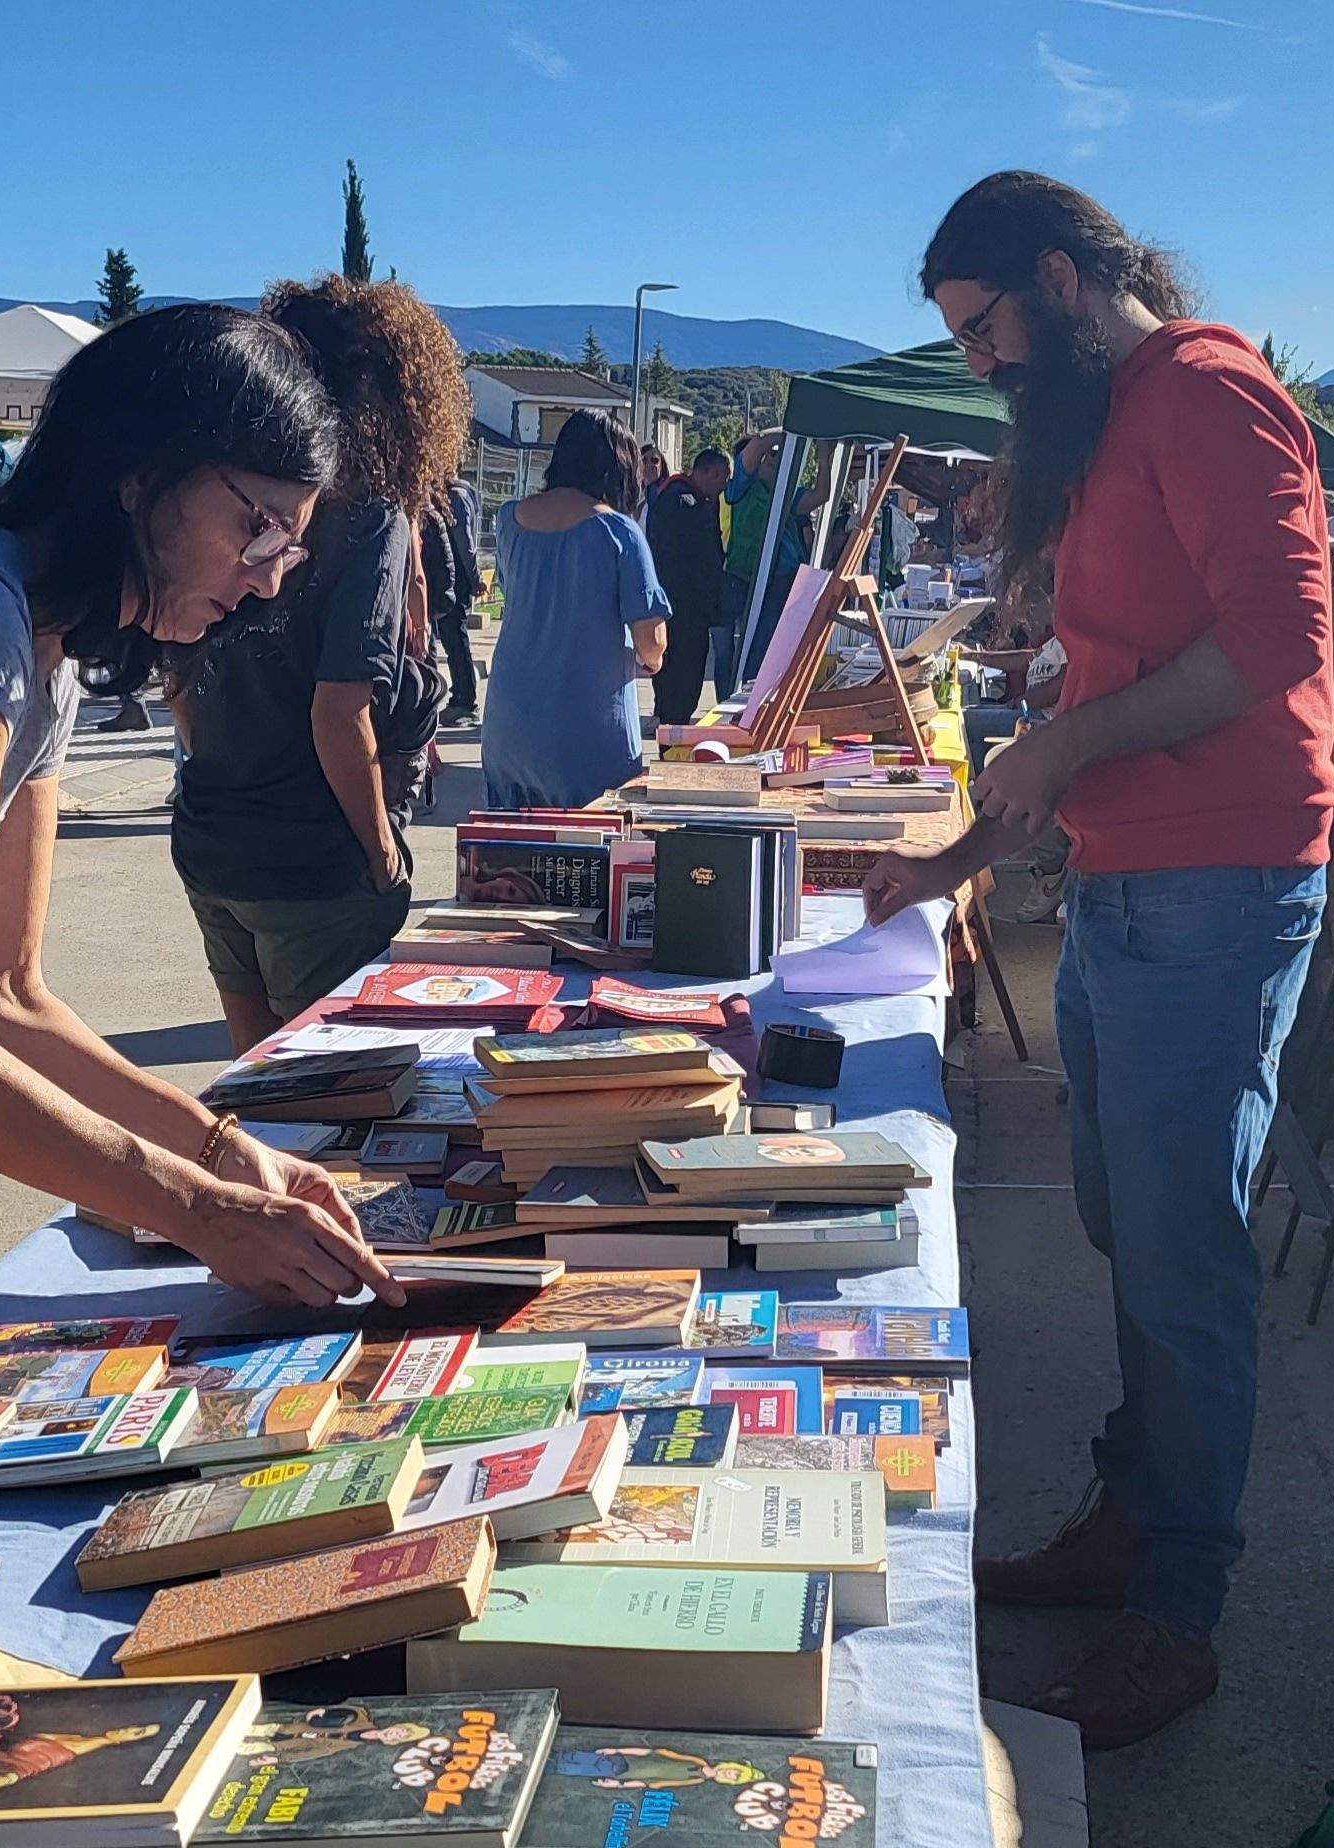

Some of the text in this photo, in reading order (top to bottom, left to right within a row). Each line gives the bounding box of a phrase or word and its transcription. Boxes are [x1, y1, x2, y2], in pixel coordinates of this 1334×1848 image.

[404, 1352, 424, 1364] DE
[430, 1341, 448, 1350] EL
[603, 1358, 690, 1369] Girona
[389, 1364, 415, 1388] LEYRE
[403, 1349, 444, 1396] MONASTERIO
[879, 1404, 902, 1434] CUENCA
[761, 1486, 781, 1548] REPRESENTACIÓN
[785, 1497, 801, 1531] MEMORIA
[675, 1581, 704, 1630] DE HIERRO
[704, 1577, 735, 1636] EN EL GALLO
[392, 1736, 451, 1788] CLUB
[422, 1709, 497, 1815] FUTBOL
[264, 1787, 310, 1824] FABI
[637, 1790, 681, 1829] FÉLIX
[733, 1780, 786, 1831] CLUB
